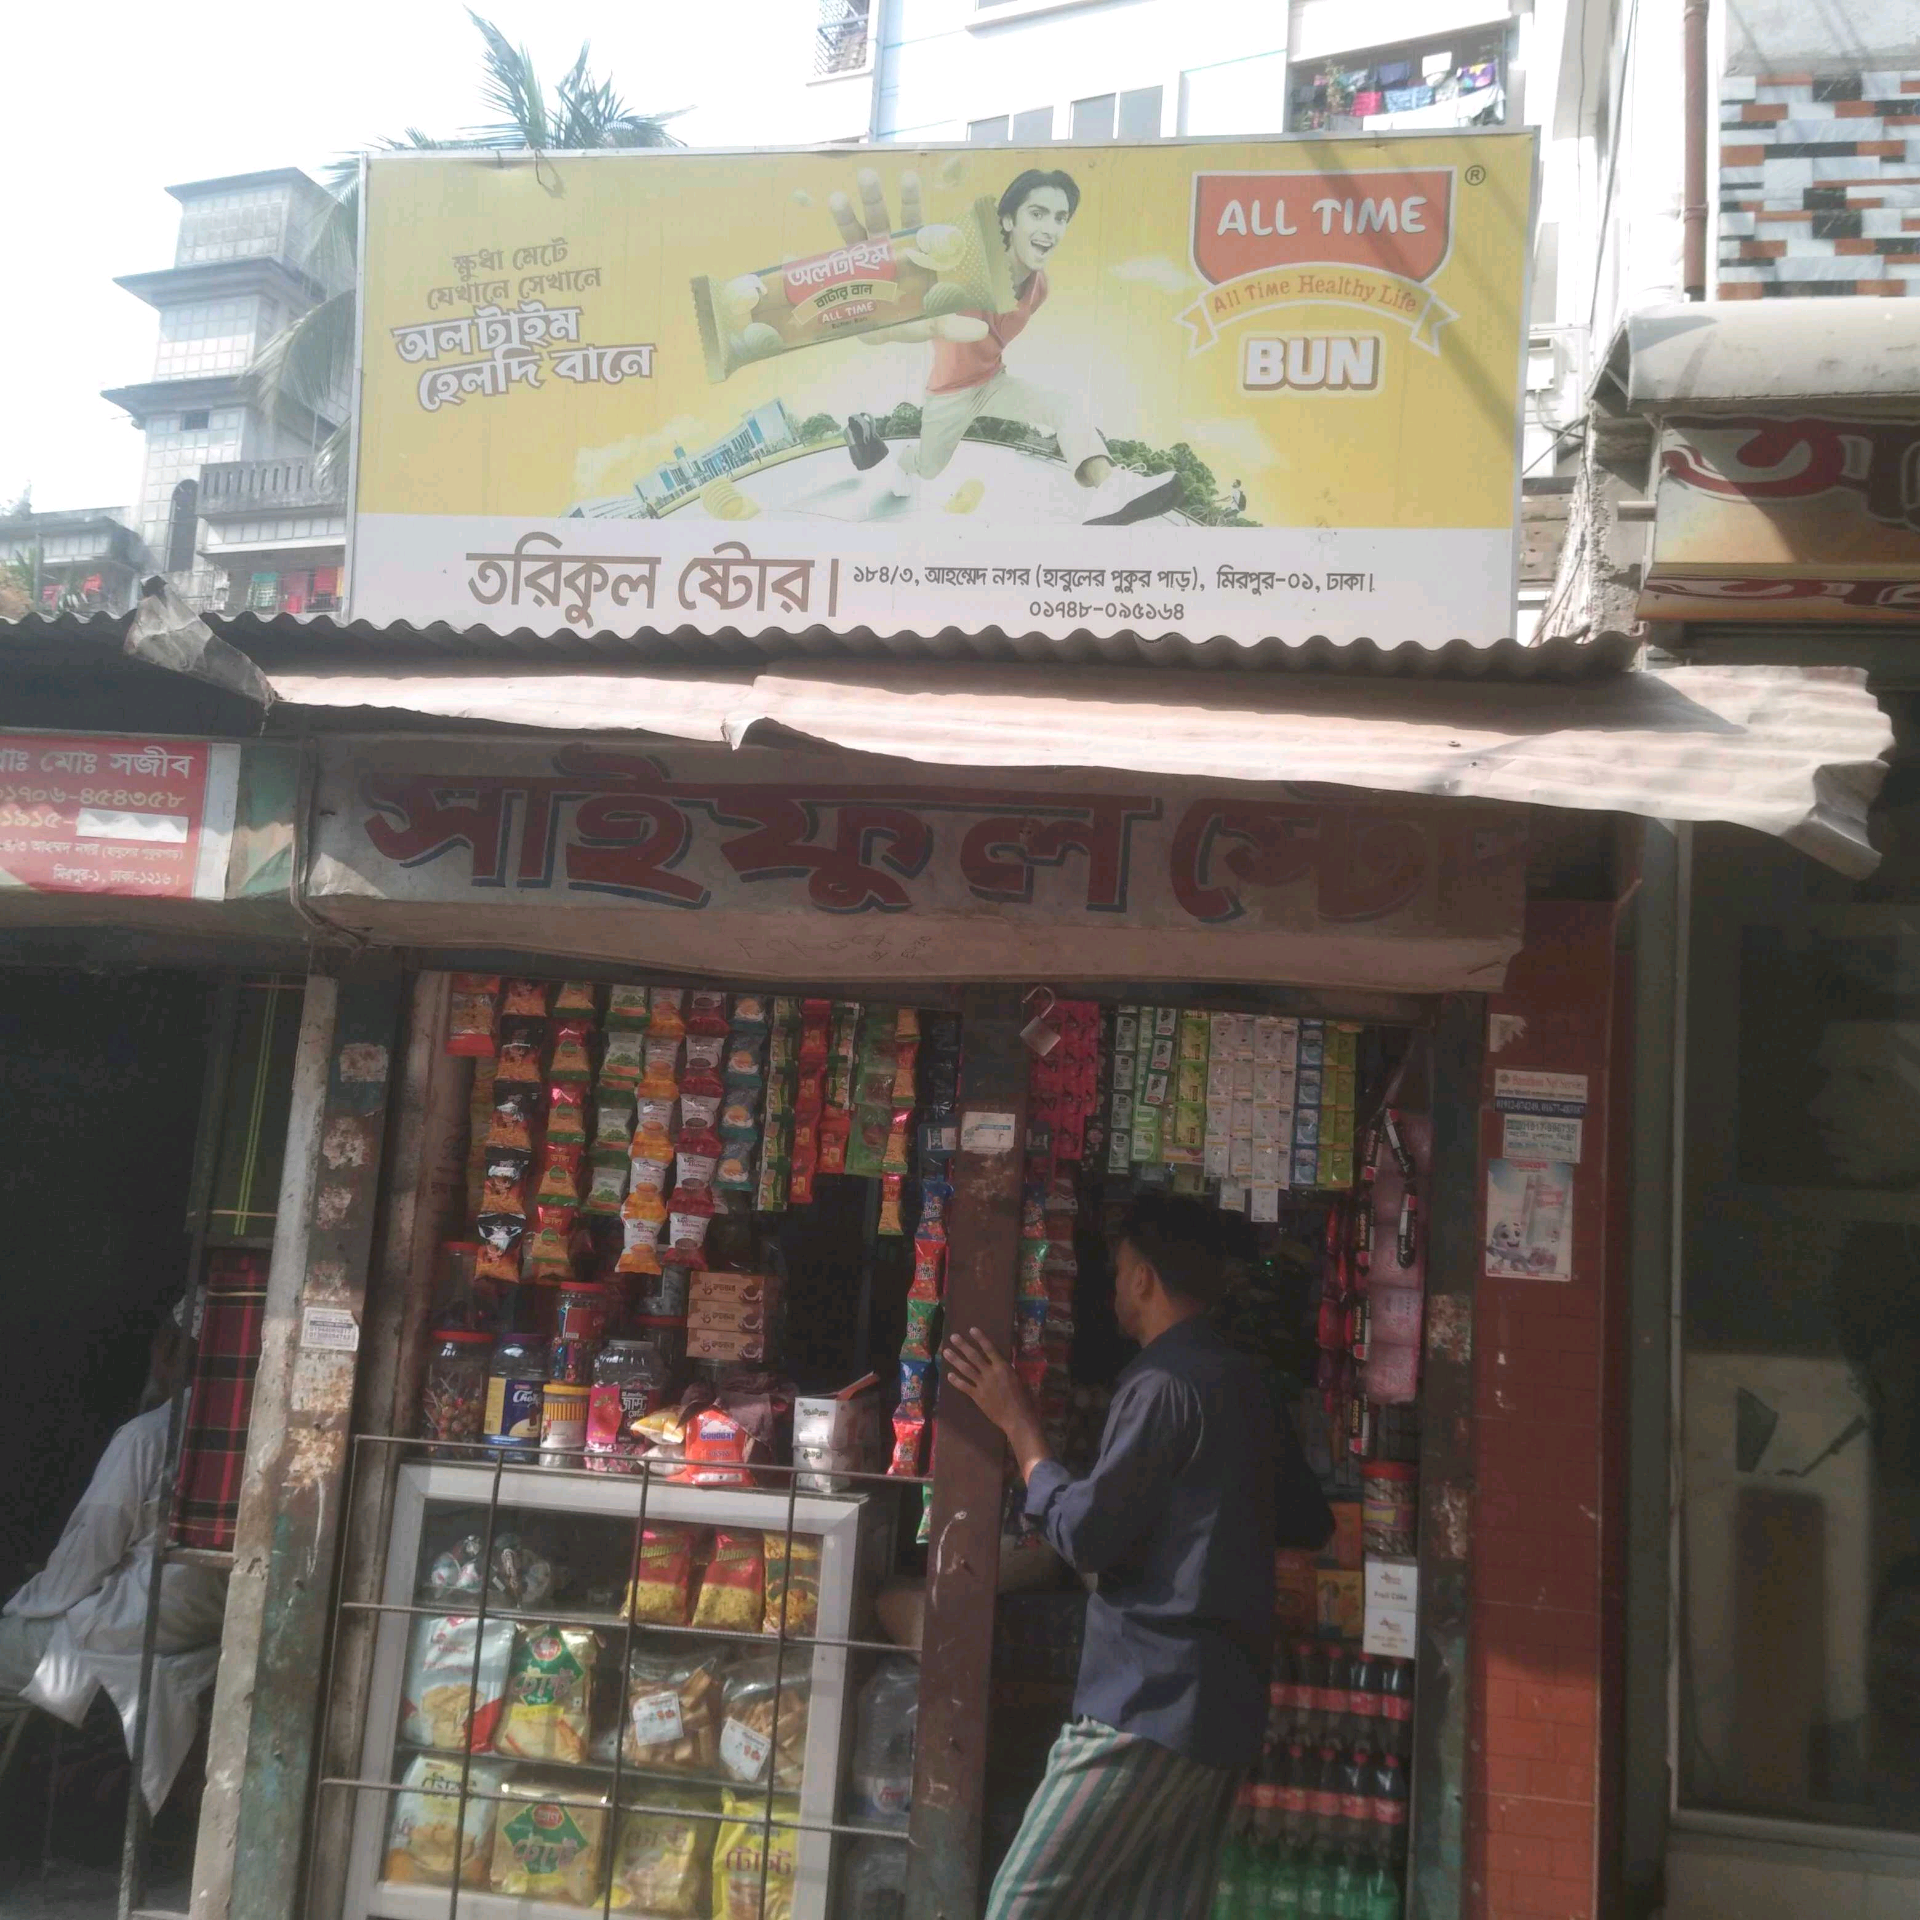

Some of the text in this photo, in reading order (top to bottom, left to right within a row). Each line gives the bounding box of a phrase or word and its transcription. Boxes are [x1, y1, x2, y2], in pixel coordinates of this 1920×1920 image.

[1216, 195, 1427, 236] ALL TIME
[452, 237, 569, 282] ক্ষুধা মেটে
[427, 267, 602, 310] যেখানে সেখানে
[1213, 291, 1241, 315] All
[1297, 274, 1377, 303] Healthy
[1377, 284, 1417, 313] Life
[821, 301, 875, 323] ALL TIME
[418, 343, 656, 412] হেলদি বানে
[1243, 335, 1379, 391] BUN
[466, 531, 662, 629] তরিকুল
[992, 568, 1030, 587] নগর
[1035, 564, 1106, 593] (হাবুলের
[1110, 569, 1152, 595] পুকুর
[40, 750, 98, 775] মোঃ
[109, 745, 196, 780] সজীব
